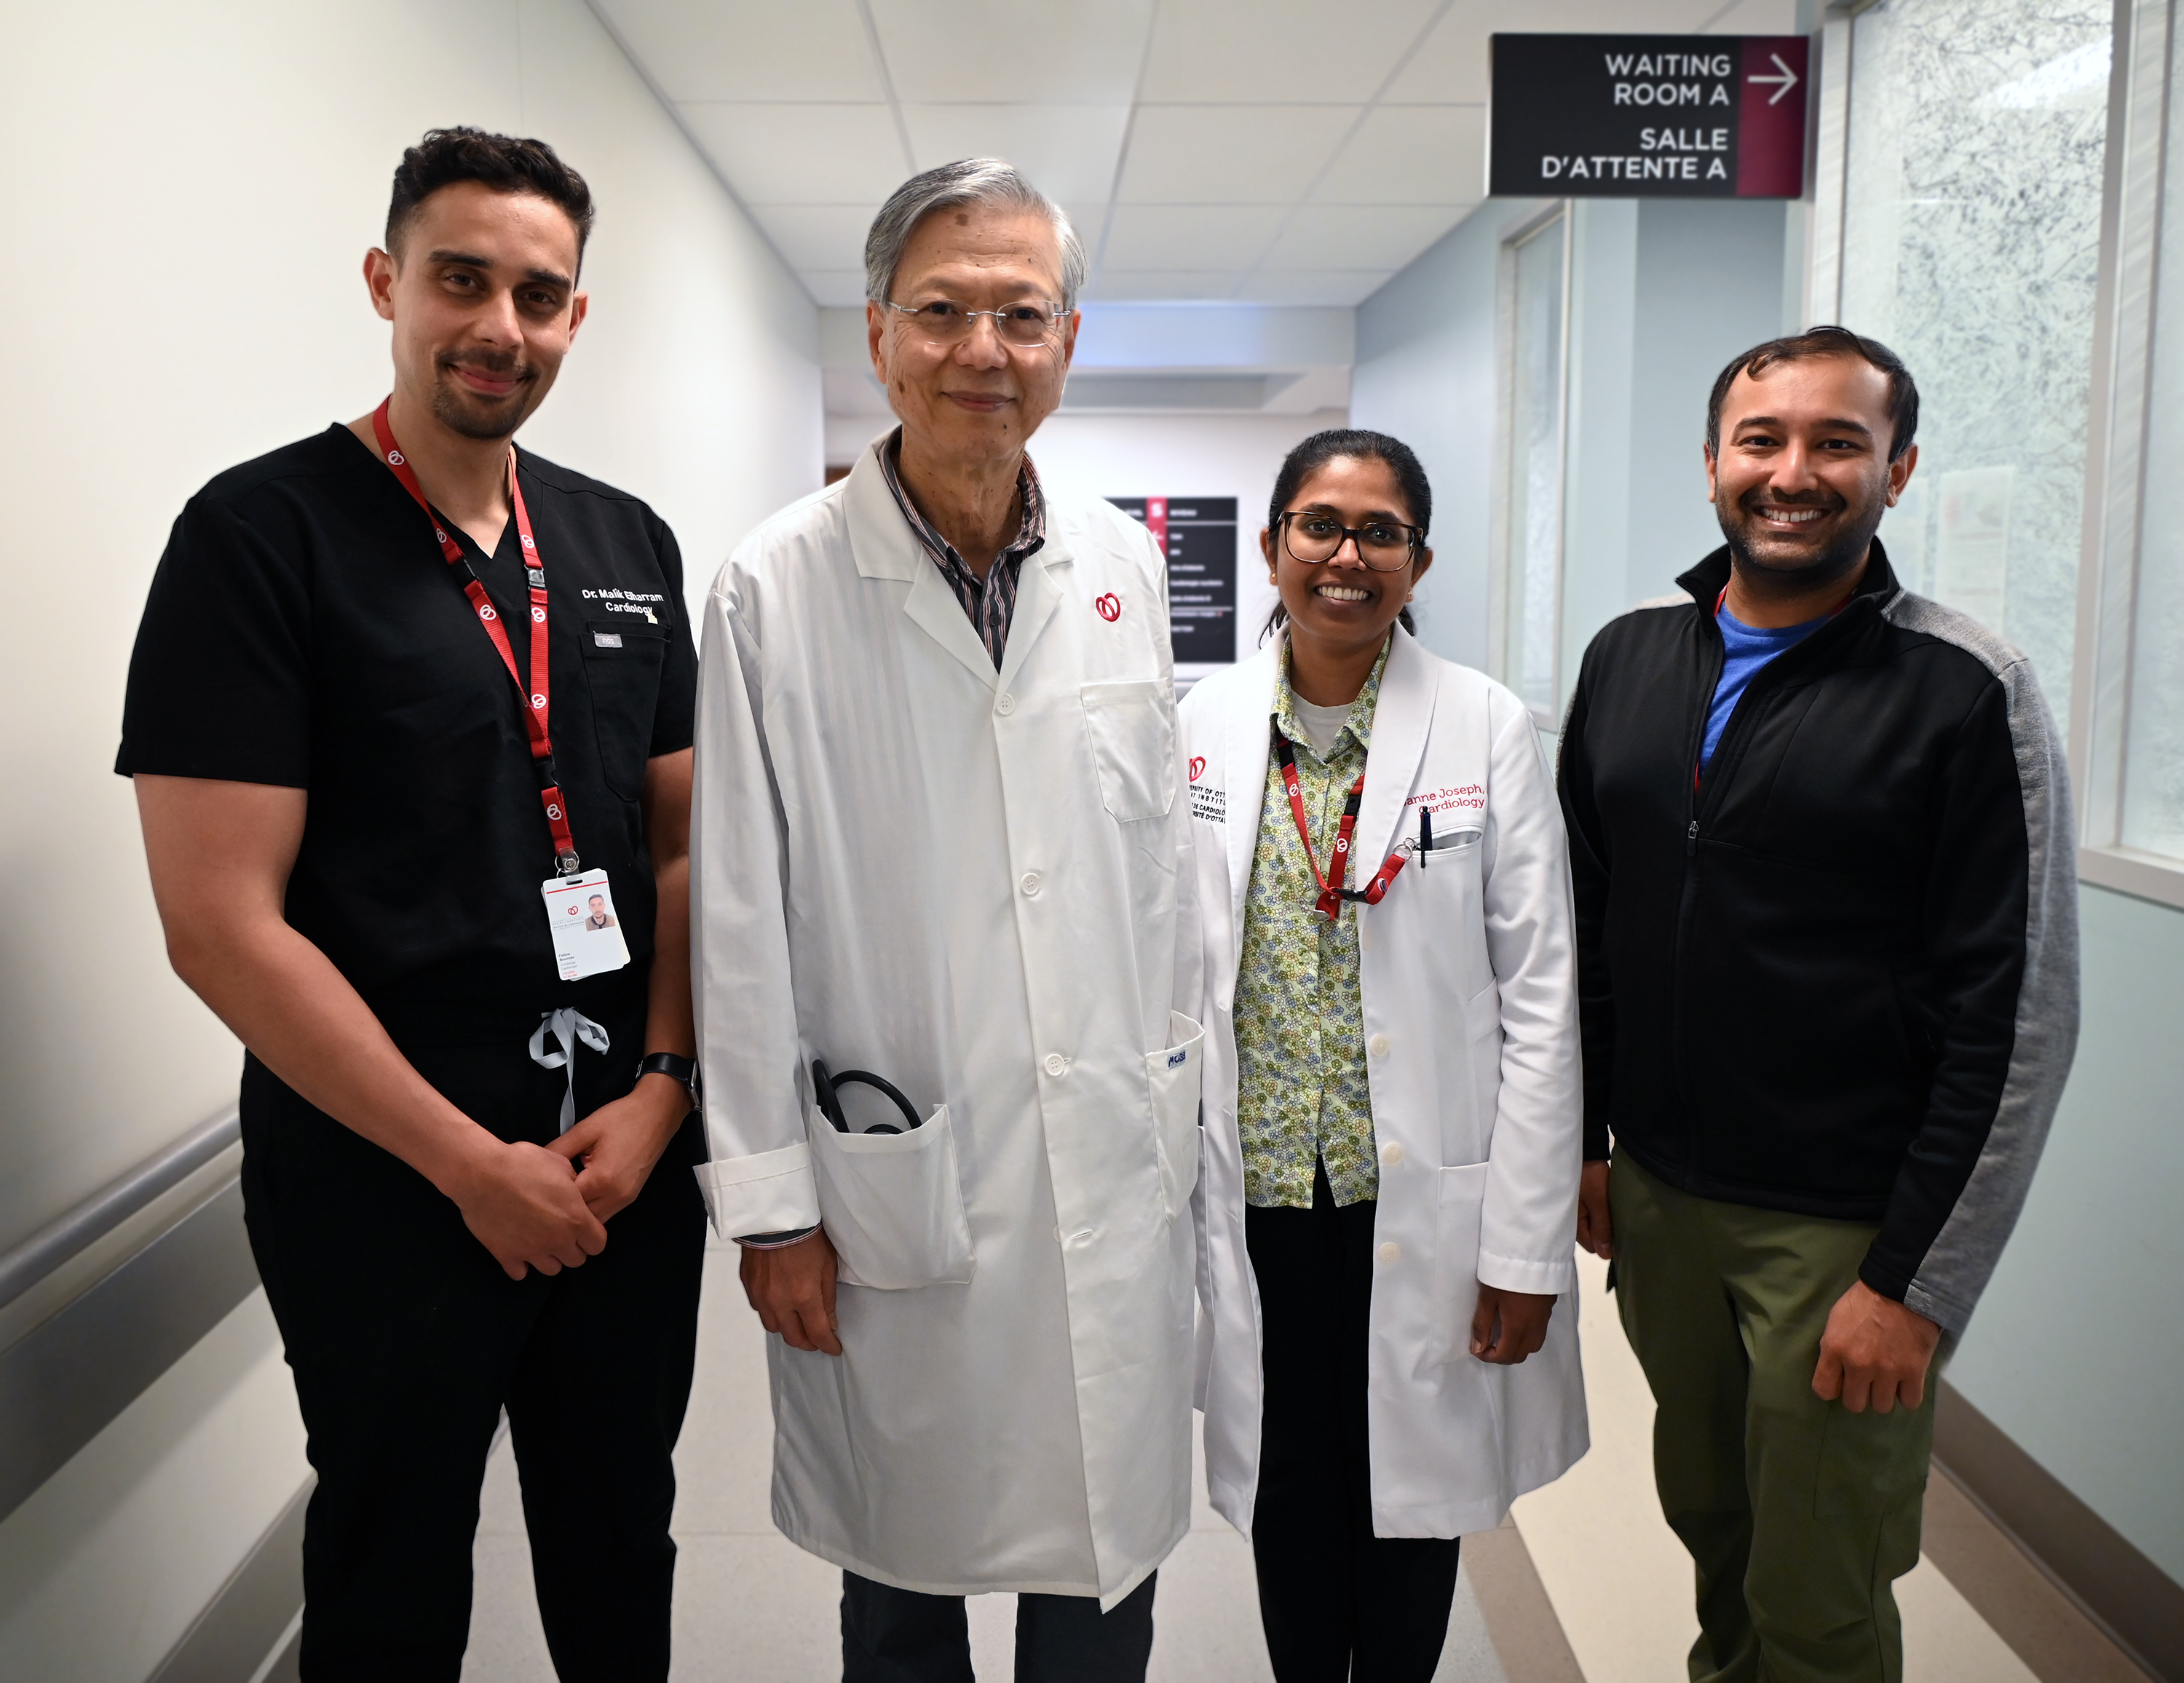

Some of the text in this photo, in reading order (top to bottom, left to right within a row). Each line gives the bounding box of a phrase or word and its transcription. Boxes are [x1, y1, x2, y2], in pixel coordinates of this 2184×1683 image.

[1605, 54, 1731, 76] WAITING
[1613, 83, 1730, 106] ROOM A
[1639, 128, 1729, 151] SALLE
[1541, 156, 1728, 179] D'ATTENTE A
[582, 588, 664, 602] Dr. Malik Elharram
[605, 601, 653, 616] Cardiology
[1439, 784, 1485, 799] Joseph,
[1418, 798, 1485, 815] Cardiology
